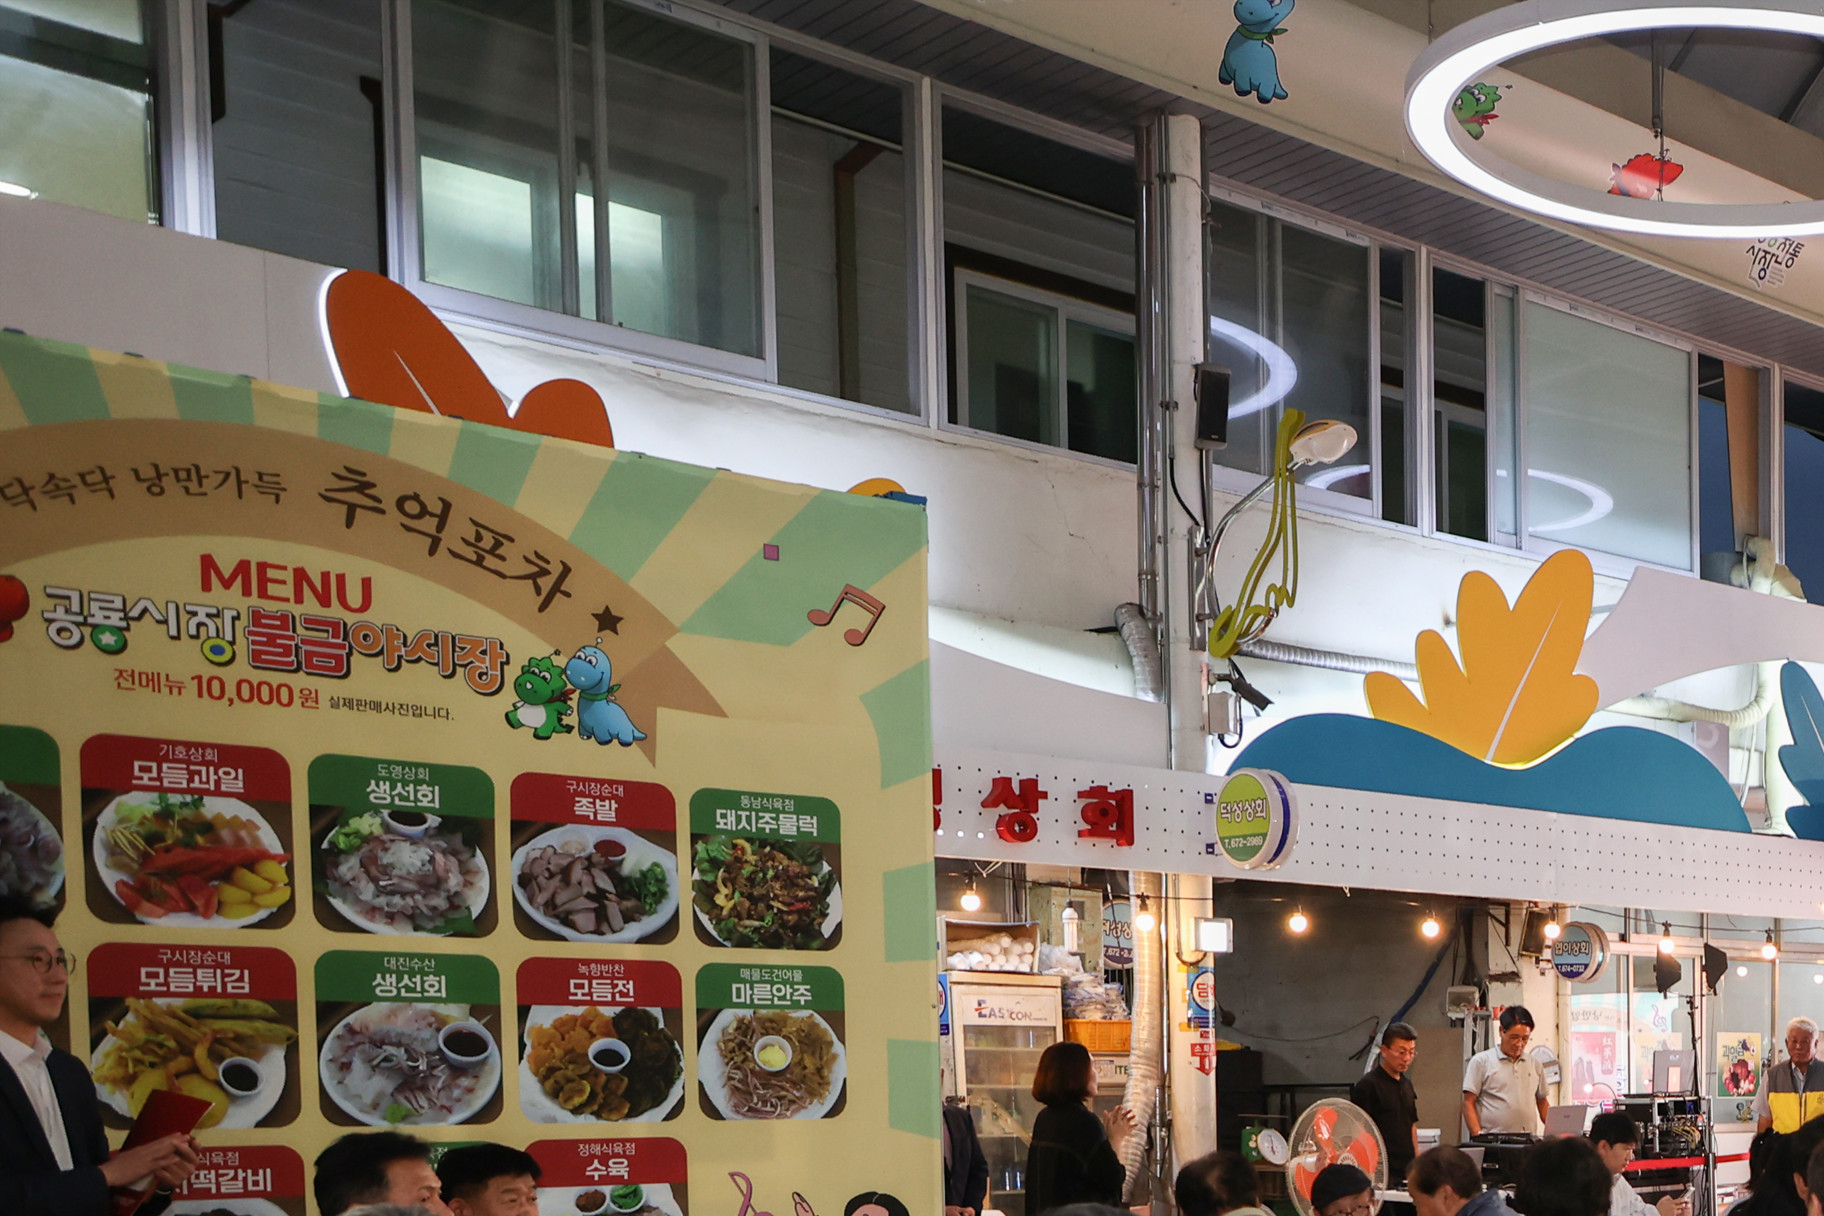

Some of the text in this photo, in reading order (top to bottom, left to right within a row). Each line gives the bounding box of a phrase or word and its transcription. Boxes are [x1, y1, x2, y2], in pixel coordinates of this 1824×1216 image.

[131, 462, 288, 505] 낭만가득
[318, 463, 577, 614] 추억포차
[200, 553, 373, 614] MENU
[41, 585, 511, 697] 공룡시장 불금야시장
[112, 667, 188, 697] 전메뉴
[328, 695, 455, 721] 실제판매사진입니다.
[159, 744, 218, 763] 기호상회
[132, 760, 245, 793] 모듬과일
[377, 763, 430, 781] 도영상회
[366, 779, 440, 809] 생선회
[566, 780, 624, 798] 구시장순대
[573, 797, 618, 822] 족발
[1220, 798, 1267, 823] 덕성상회
[715, 809, 818, 837] 돼지주물럭
[158, 948, 231, 965] 구시장순대
[384, 956, 436, 973] 대진수산
[139, 966, 250, 995] 모듬튀김
[371, 972, 446, 998] 생선회
[740, 967, 804, 982] 매물도건어물
[568, 978, 635, 1003] 모듬전
[731, 983, 813, 1007] 마른안주
[578, 1143, 636, 1157] 정해식육점
[585, 1157, 630, 1181] 수육
